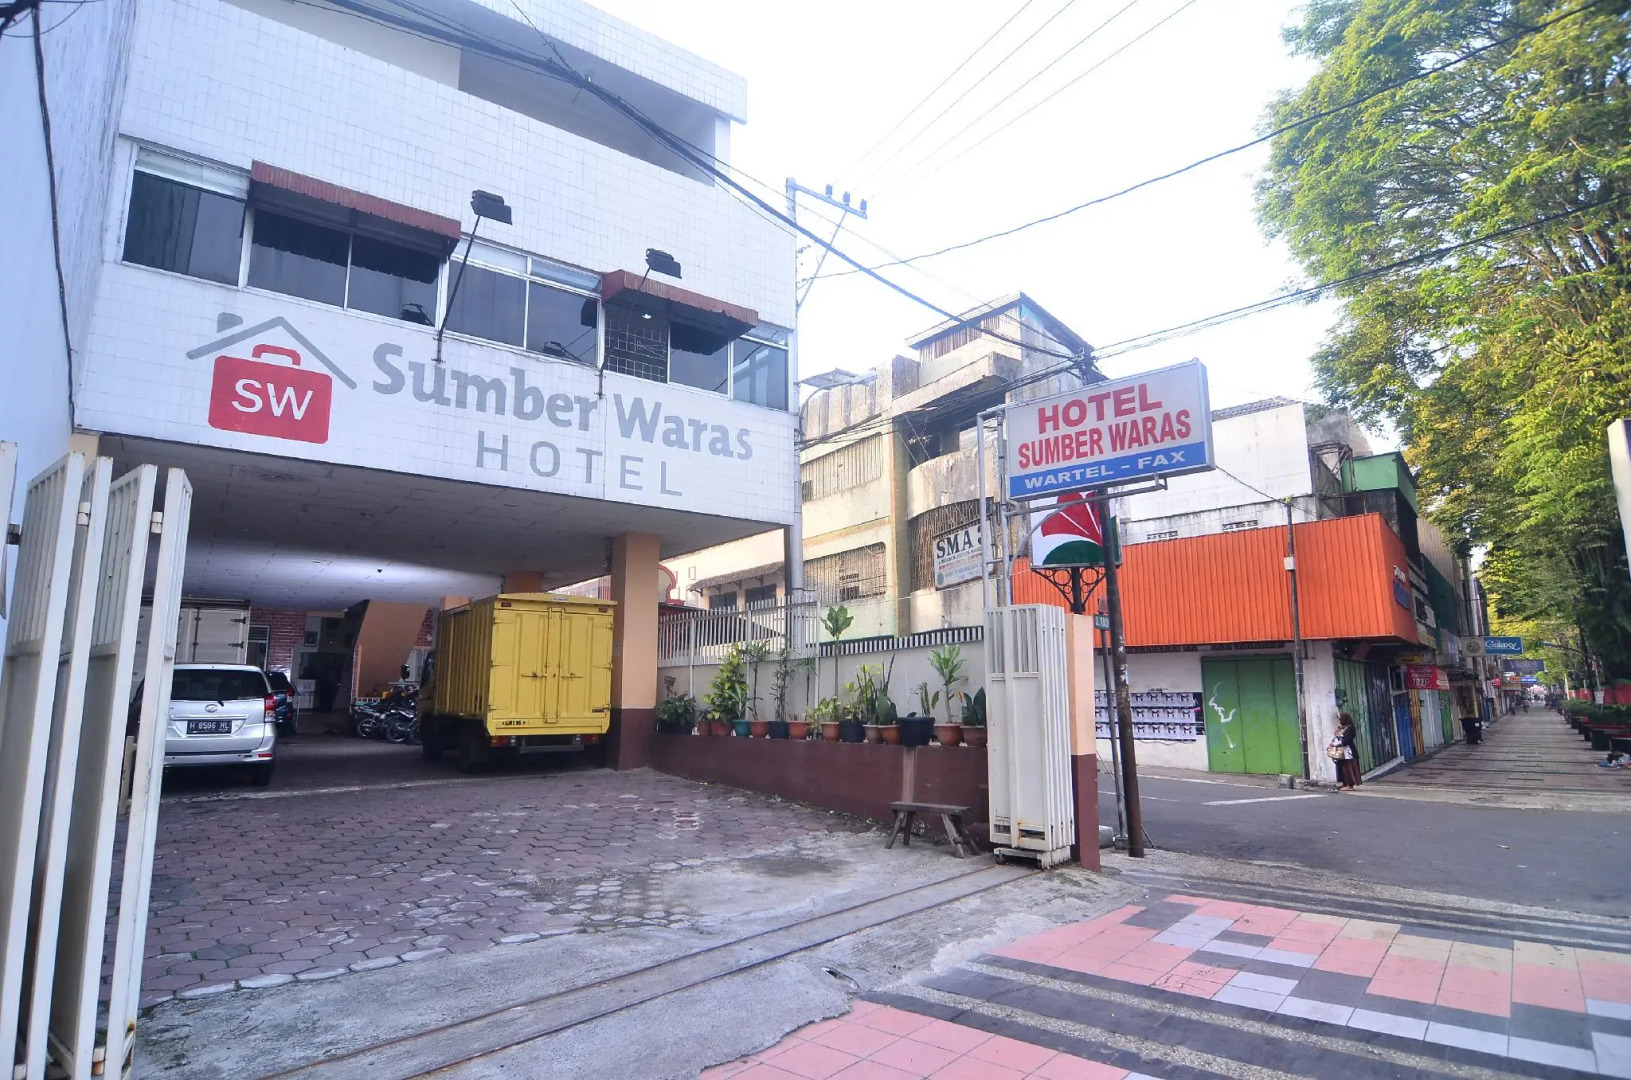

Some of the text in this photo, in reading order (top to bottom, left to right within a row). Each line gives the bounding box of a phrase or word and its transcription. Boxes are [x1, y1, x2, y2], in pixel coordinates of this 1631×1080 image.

[231, 378, 314, 421] SW
[373, 342, 754, 460] Sumber Waras
[1038, 383, 1163, 434] HOTEL
[1018, 409, 1191, 469] SUMBER WARAS
[476, 430, 682, 497] HOTEL
[1024, 464, 1115, 489] WARTEL
[1138, 450, 1186, 470] FAX
[937, 530, 974, 559] SMA
[1485, 640, 1520, 651] Galaxy
